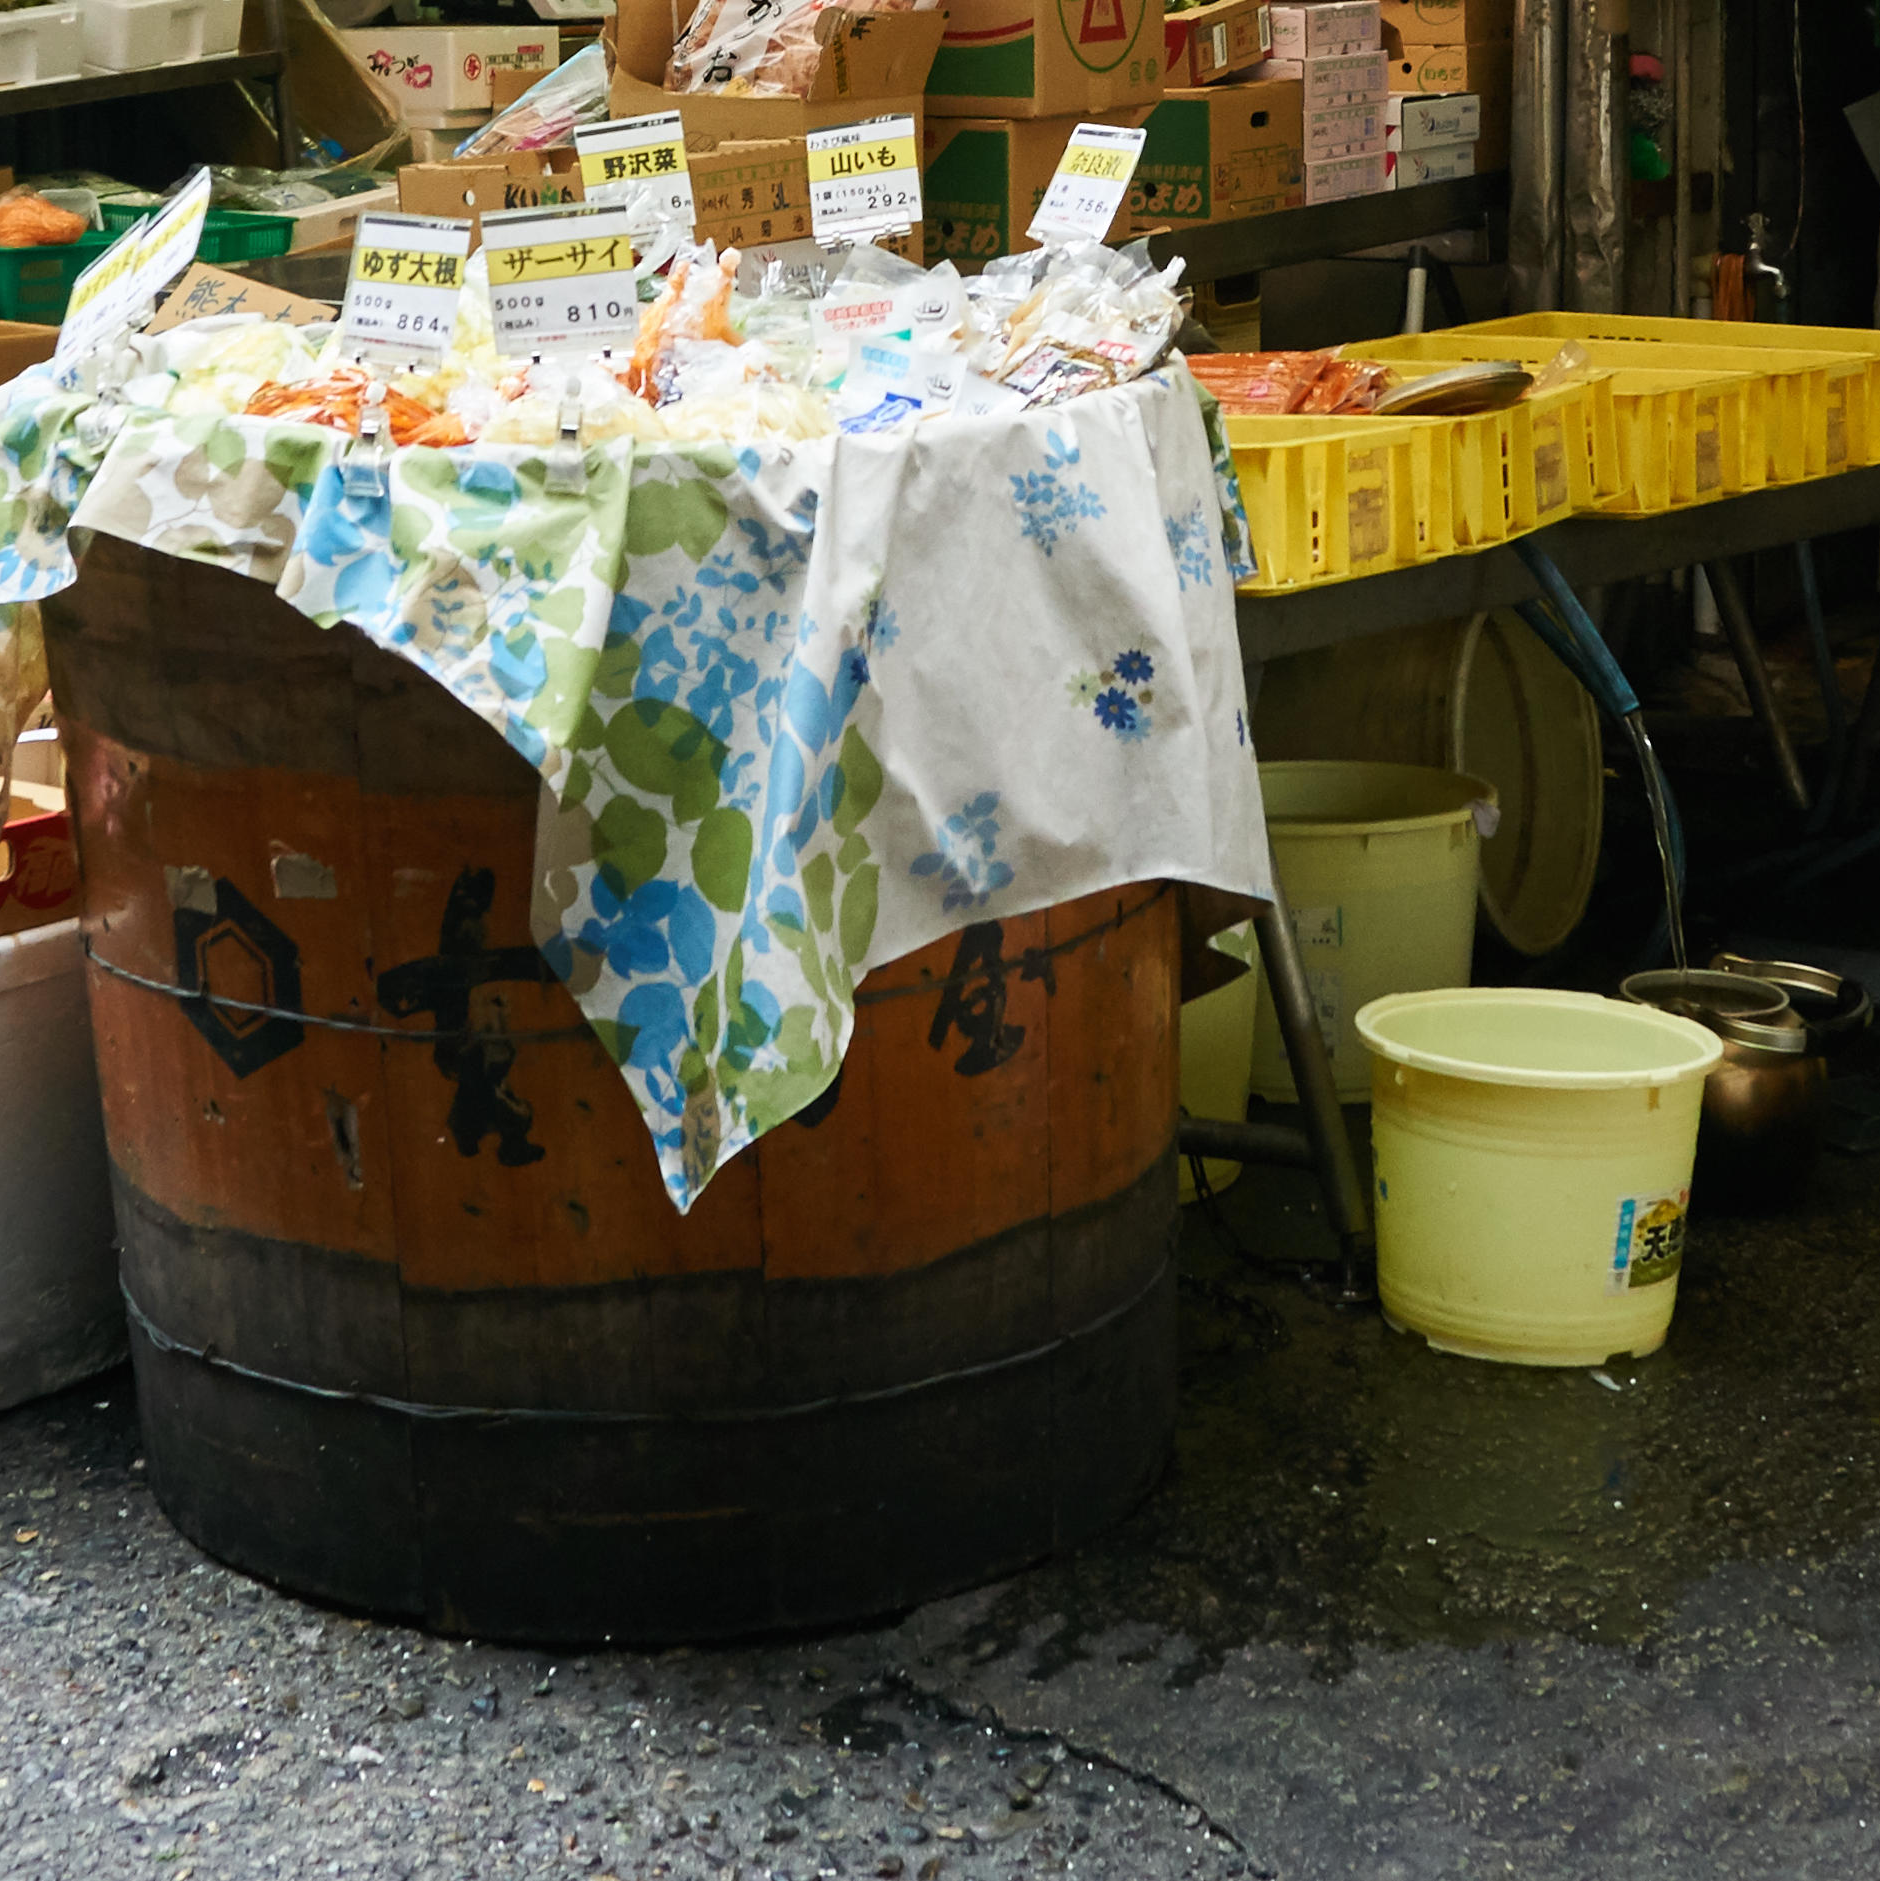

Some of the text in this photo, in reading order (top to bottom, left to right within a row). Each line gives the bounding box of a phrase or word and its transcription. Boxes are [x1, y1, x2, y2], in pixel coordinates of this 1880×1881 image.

[603, 146, 679, 181] 野沢菜
[830, 145, 897, 177] 山いも
[1070, 150, 1125, 179] 奈良漬
[362, 249, 459, 287] ゆず大根
[503, 238, 622, 281] ザーサイ
[353, 293, 395, 311] 500g
[495, 296, 546, 311] 500g
